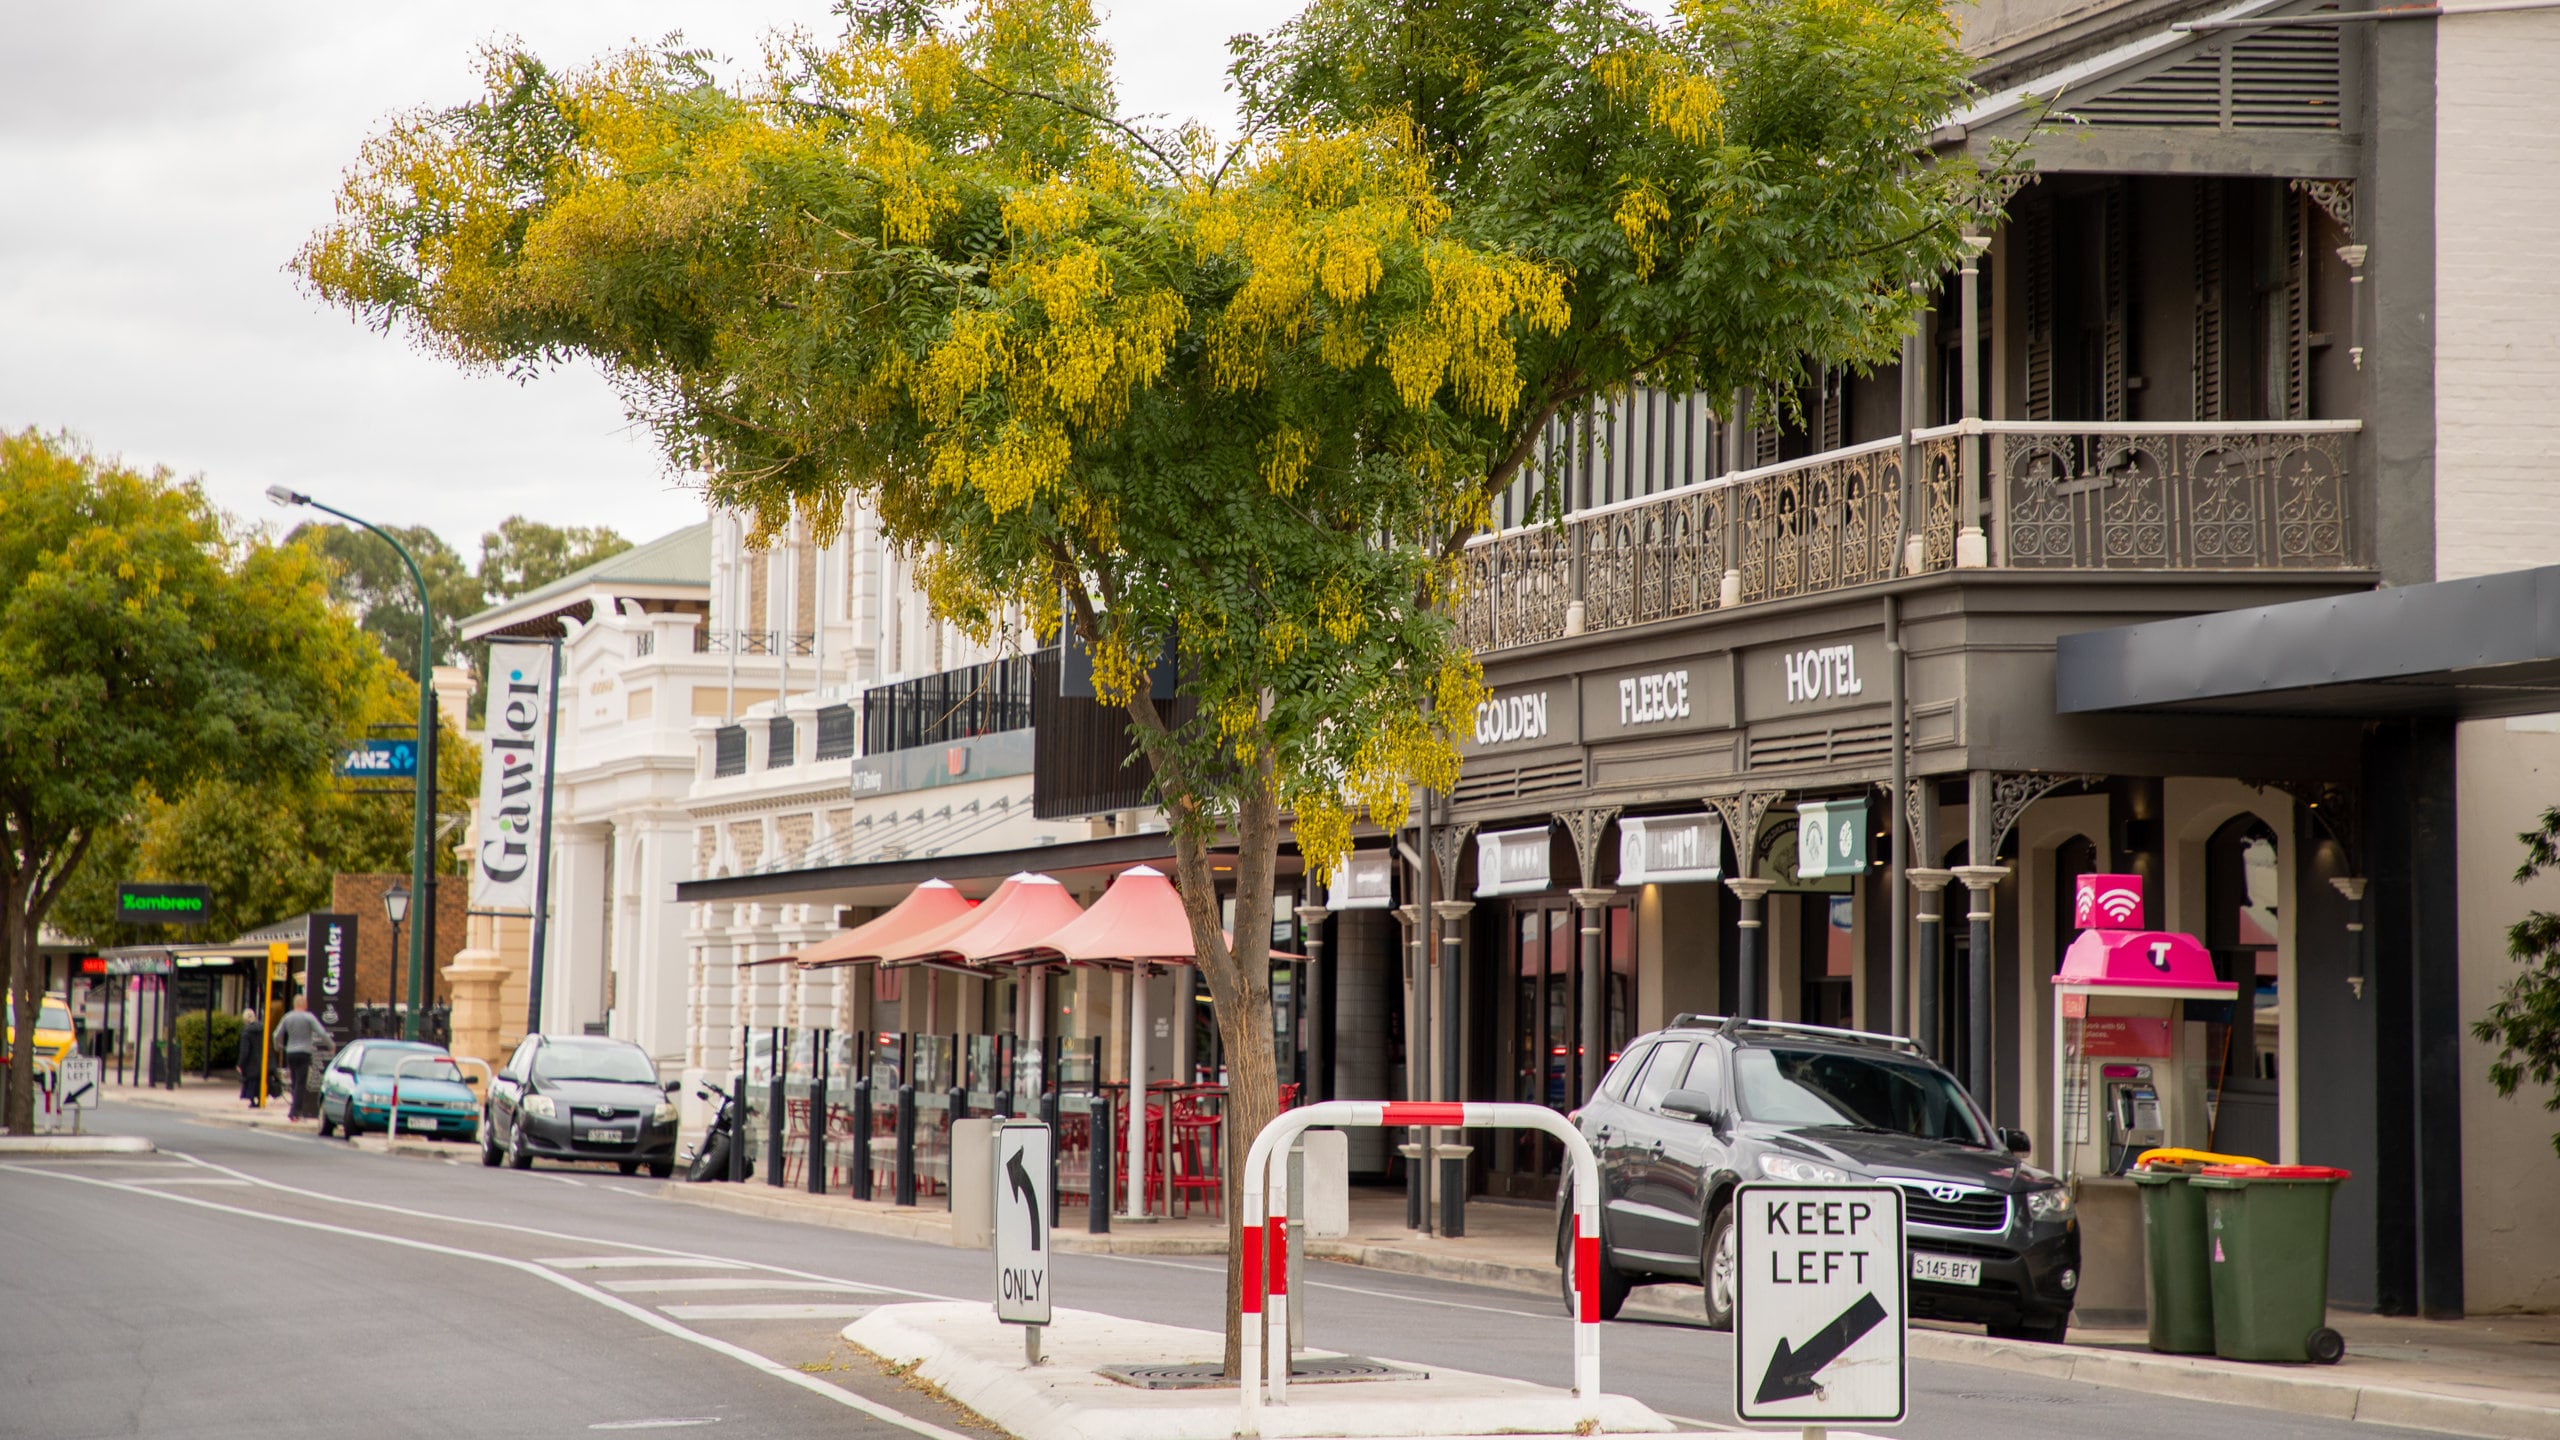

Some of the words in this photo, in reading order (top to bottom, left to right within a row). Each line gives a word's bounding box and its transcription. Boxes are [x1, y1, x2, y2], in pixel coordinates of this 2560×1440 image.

[1475, 692, 1547, 745] GOLDEN
[1619, 671, 1690, 725] FLEECE
[1785, 645, 1863, 702] HOTEL
[344, 750, 391, 769] ANZ
[482, 670, 540, 883] Gawler
[322, 921, 342, 996] Gawler
[67, 1072, 91, 1080] LEFT
[1767, 1202, 1871, 1235] KEEP
[1772, 1250, 1869, 1284] LEFT
[1003, 1268, 1043, 1301] ONLY
